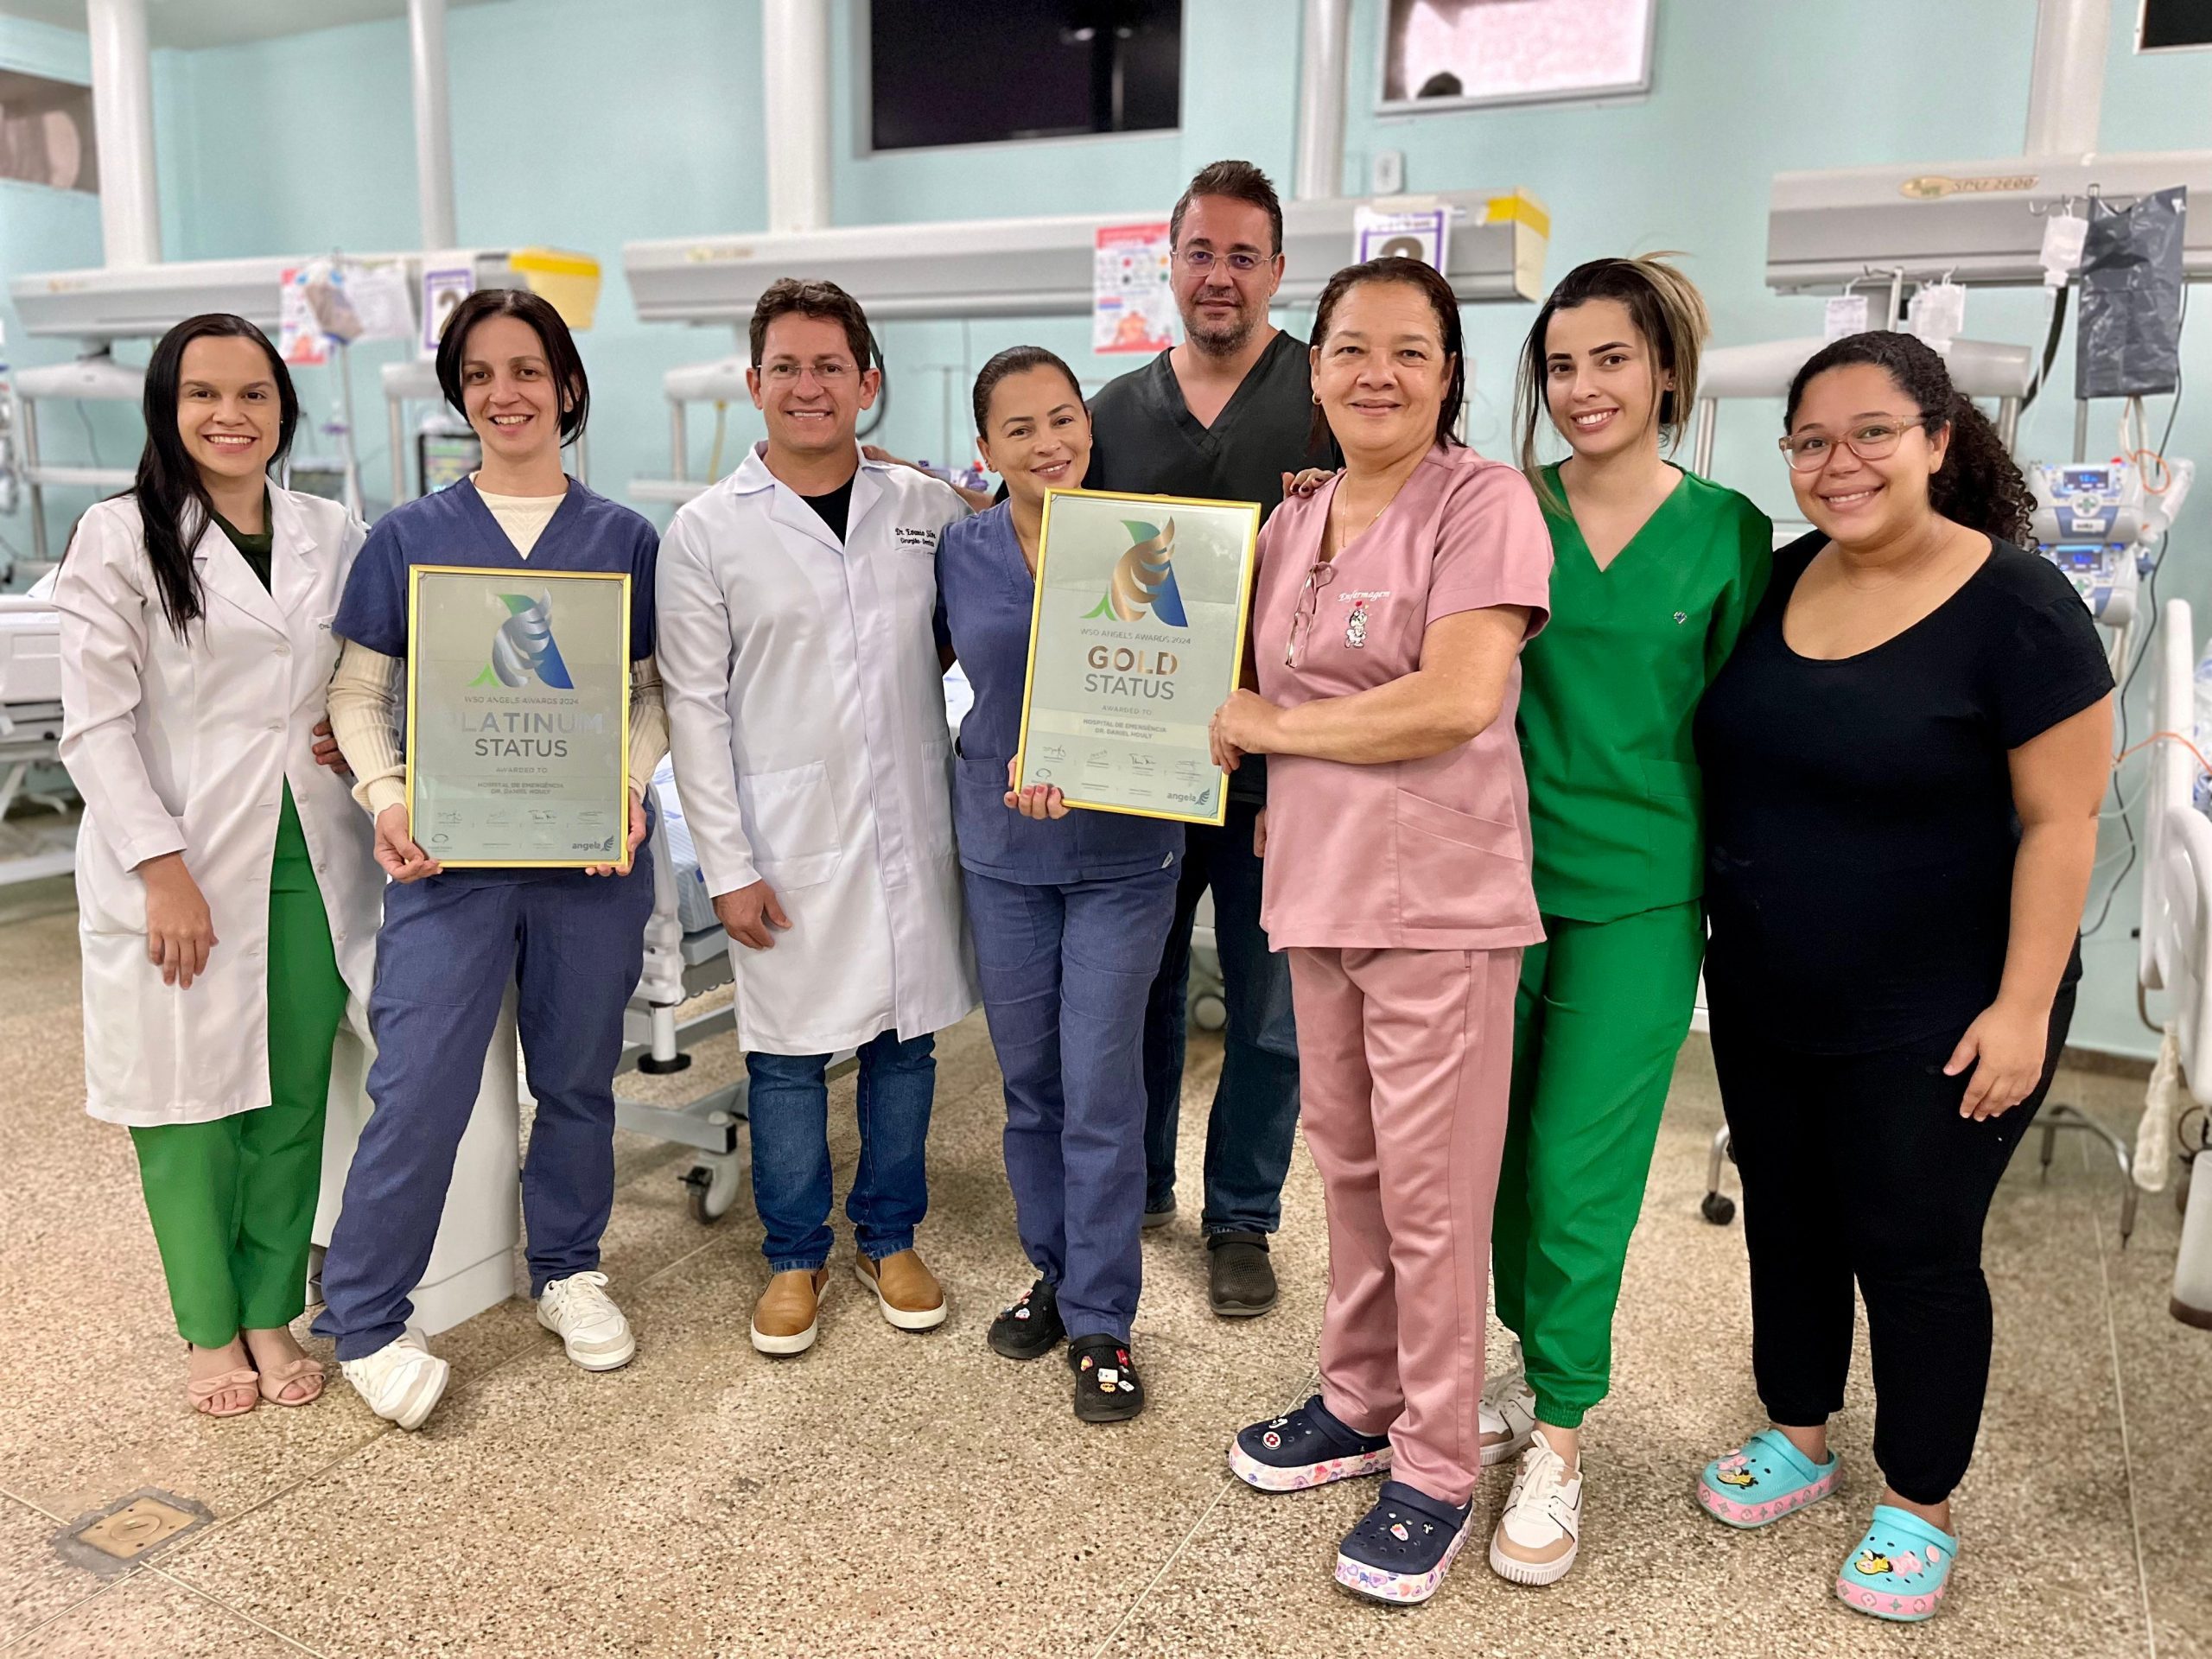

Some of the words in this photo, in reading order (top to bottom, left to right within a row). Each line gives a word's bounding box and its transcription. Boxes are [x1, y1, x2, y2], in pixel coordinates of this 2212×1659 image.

[1338, 589, 1390, 602] Enfermagem
[1080, 628, 1099, 637] WSO
[1101, 631, 1133, 640] ANGELS
[1135, 633, 1169, 643] AWARDS
[1088, 645, 1178, 676] GOLD
[1084, 673, 1174, 701] STATUS
[486, 696, 519, 705] ANGELS
[1102, 705, 1139, 715] AWARDED
[442, 711, 605, 734] LATINUM
[1083, 719, 1114, 728] HOSPITAL
[475, 738, 568, 758] STATUS
